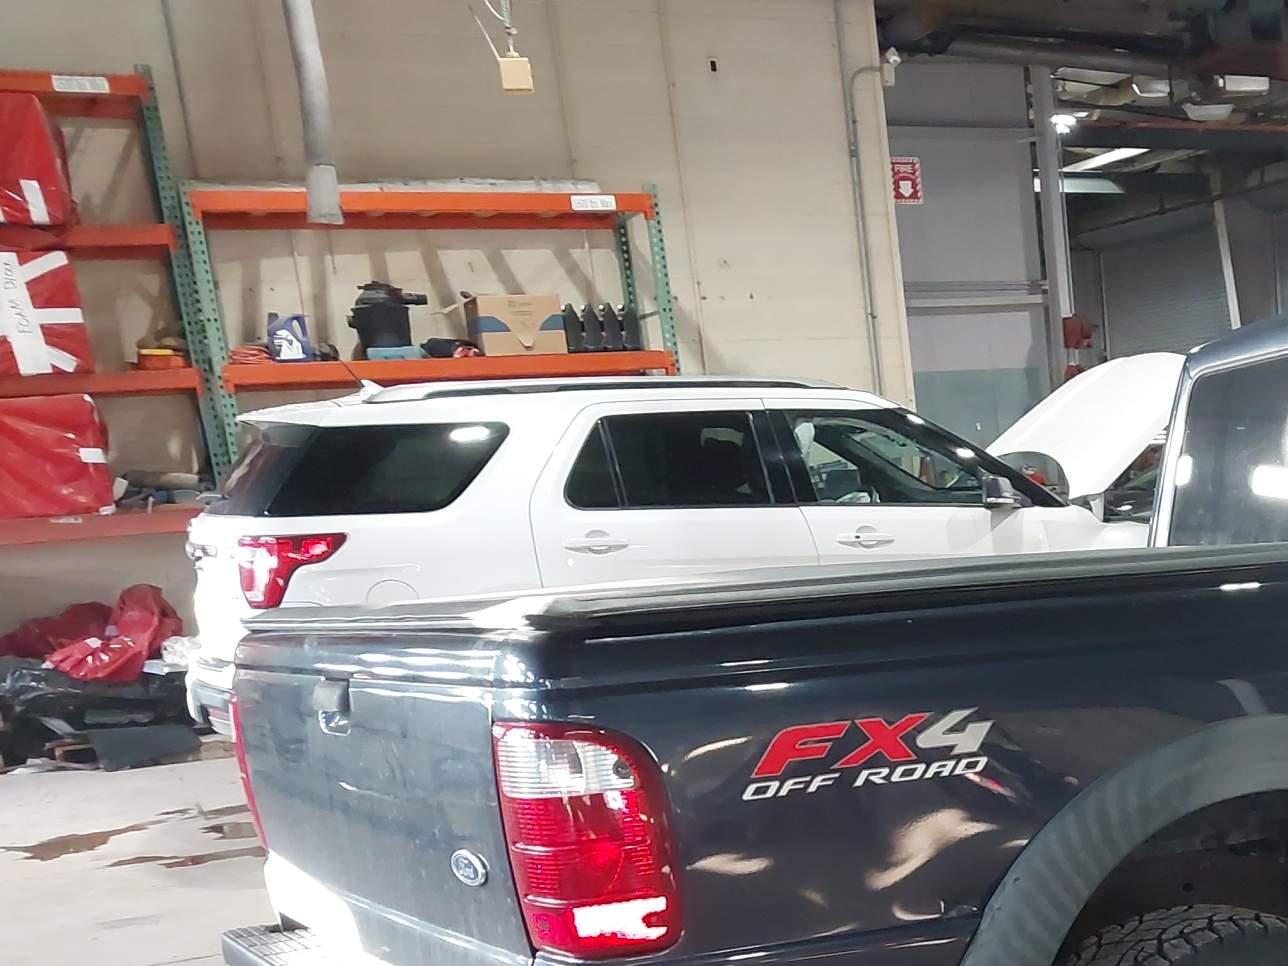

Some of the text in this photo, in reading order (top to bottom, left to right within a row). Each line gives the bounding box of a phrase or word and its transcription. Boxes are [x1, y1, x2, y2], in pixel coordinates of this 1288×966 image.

[751, 707, 994, 778] FX4
[742, 756, 988, 801] OFF ROAD
